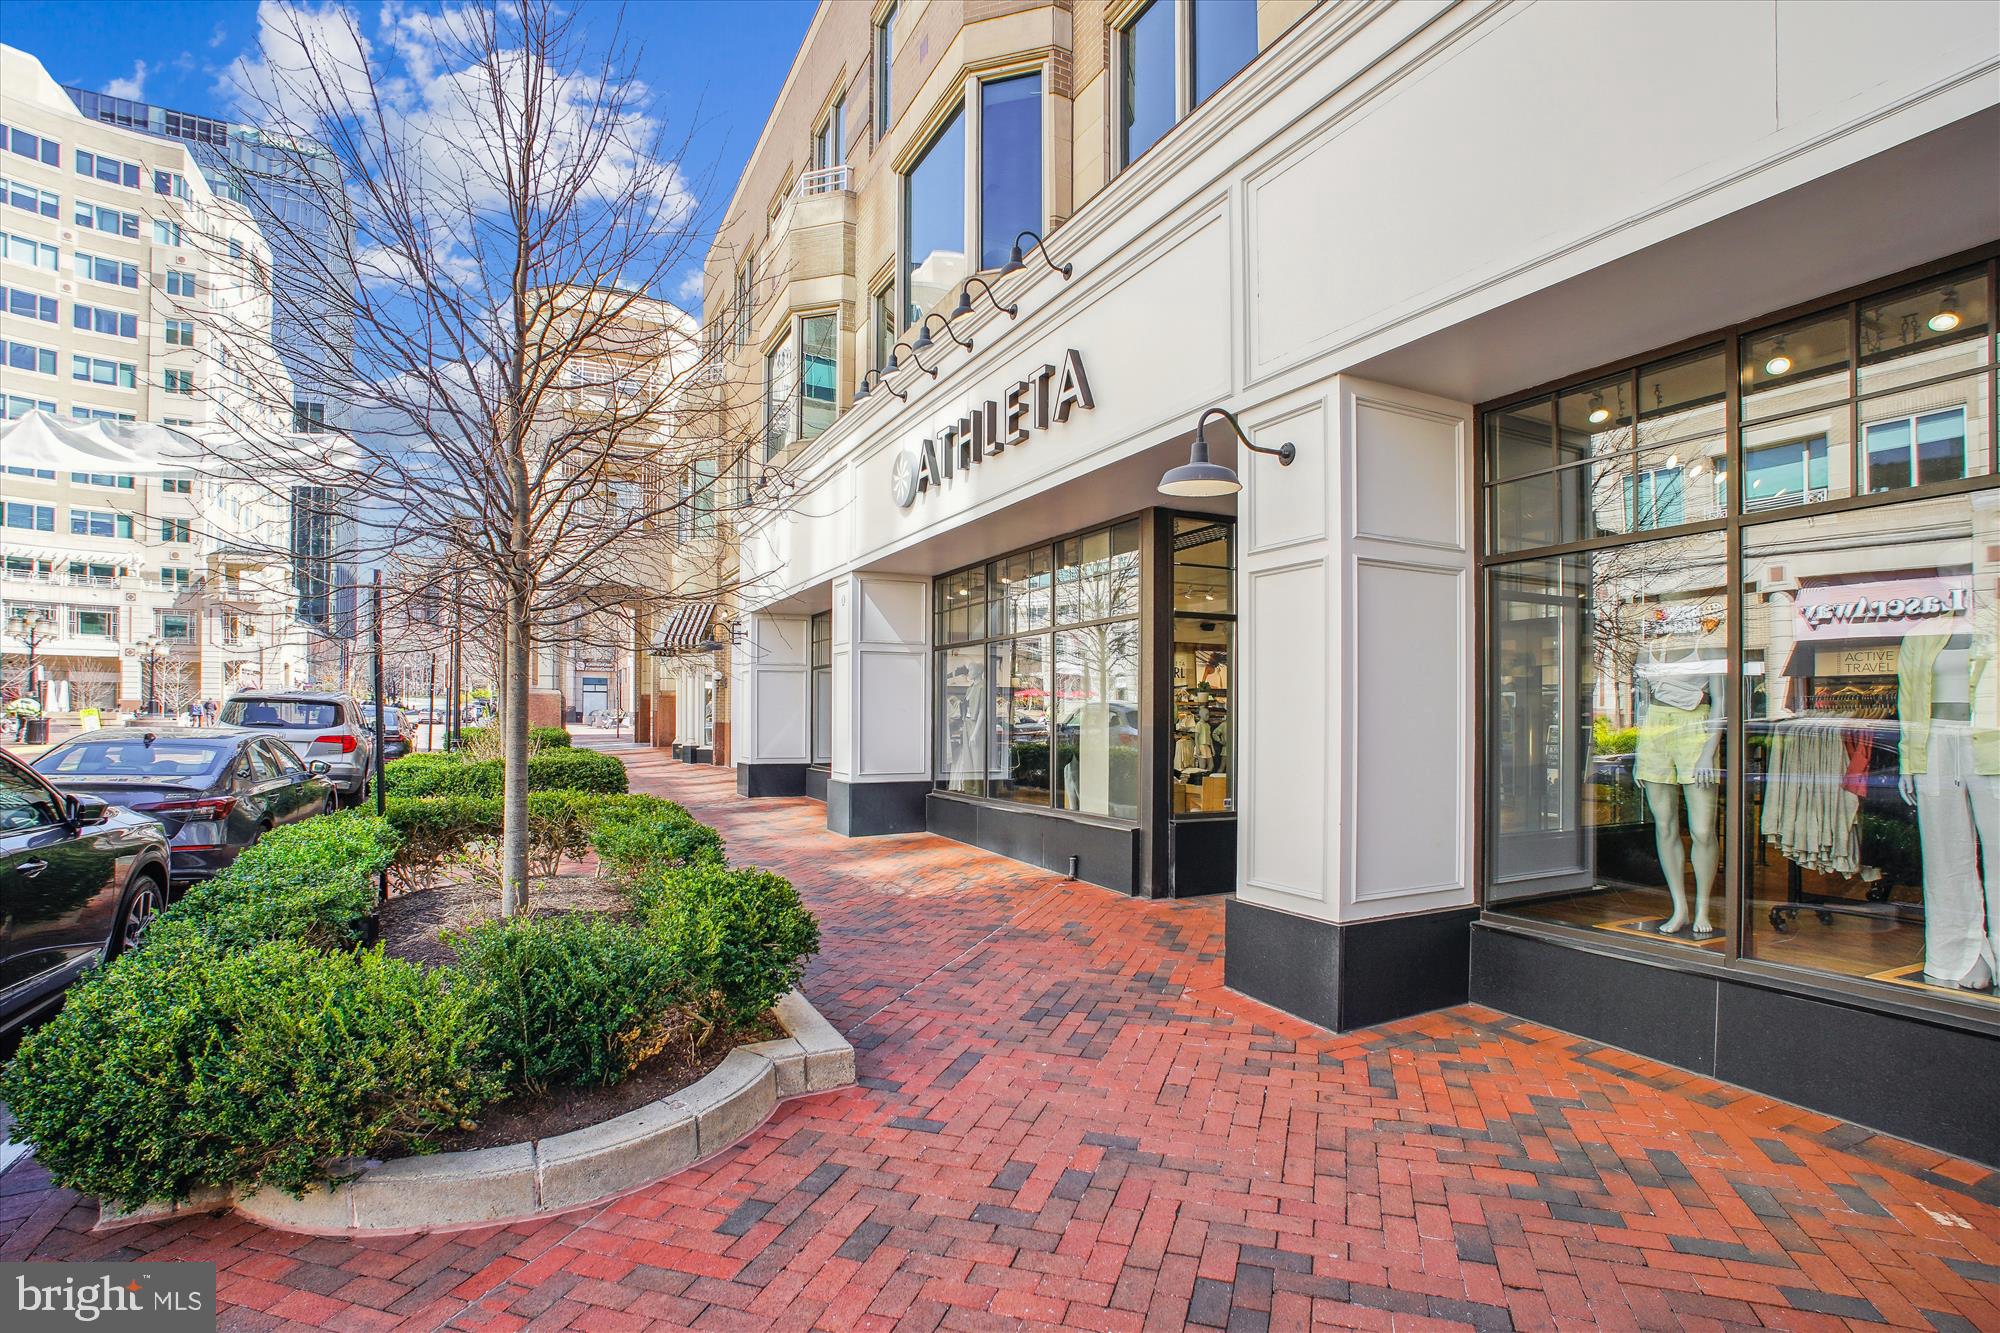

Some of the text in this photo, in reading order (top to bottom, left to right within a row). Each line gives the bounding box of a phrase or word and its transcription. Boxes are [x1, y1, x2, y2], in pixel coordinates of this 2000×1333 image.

[916, 348, 1096, 494] ATHLETA
[1845, 651, 1894, 662] ACTIVE
[1845, 663, 1894, 673] TRAVEL
